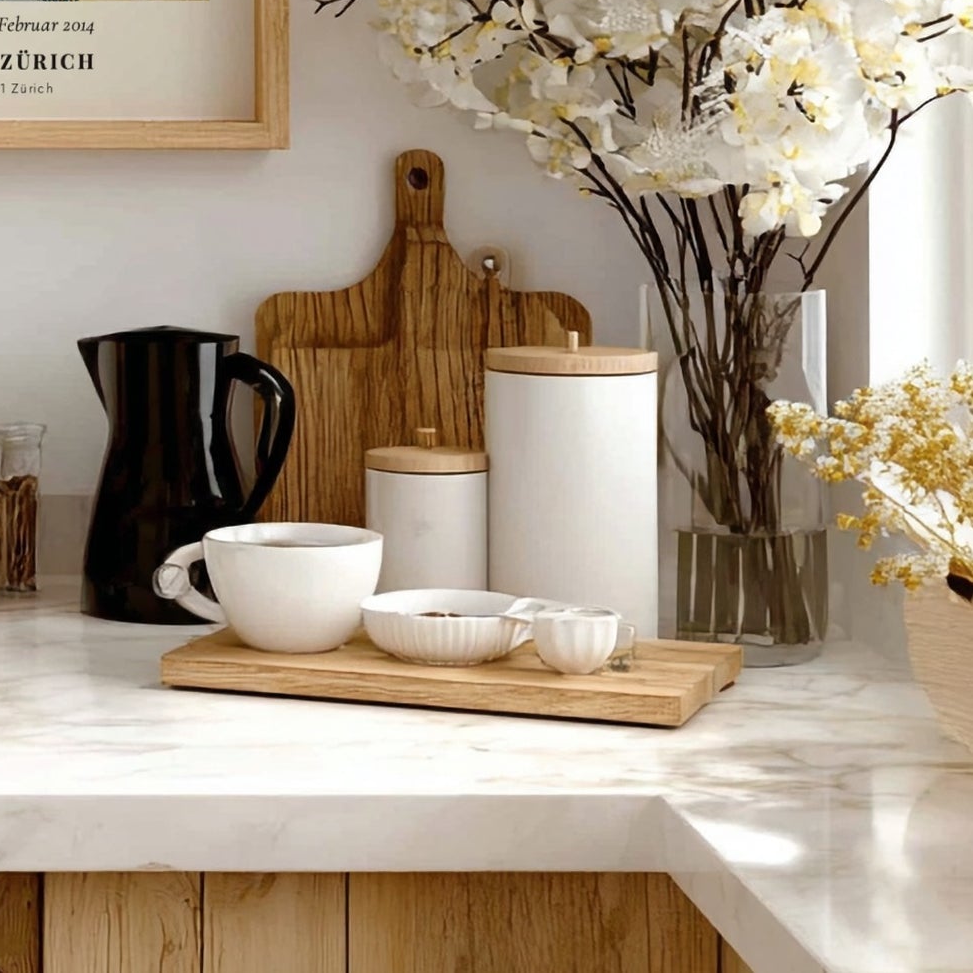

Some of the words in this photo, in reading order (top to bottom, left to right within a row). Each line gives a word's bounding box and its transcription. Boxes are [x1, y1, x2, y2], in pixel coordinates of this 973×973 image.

[63, 20, 95, 35] 2014
[0, 49, 95, 71] ZÜRICH
[11, 82, 54, 95] Zürich
